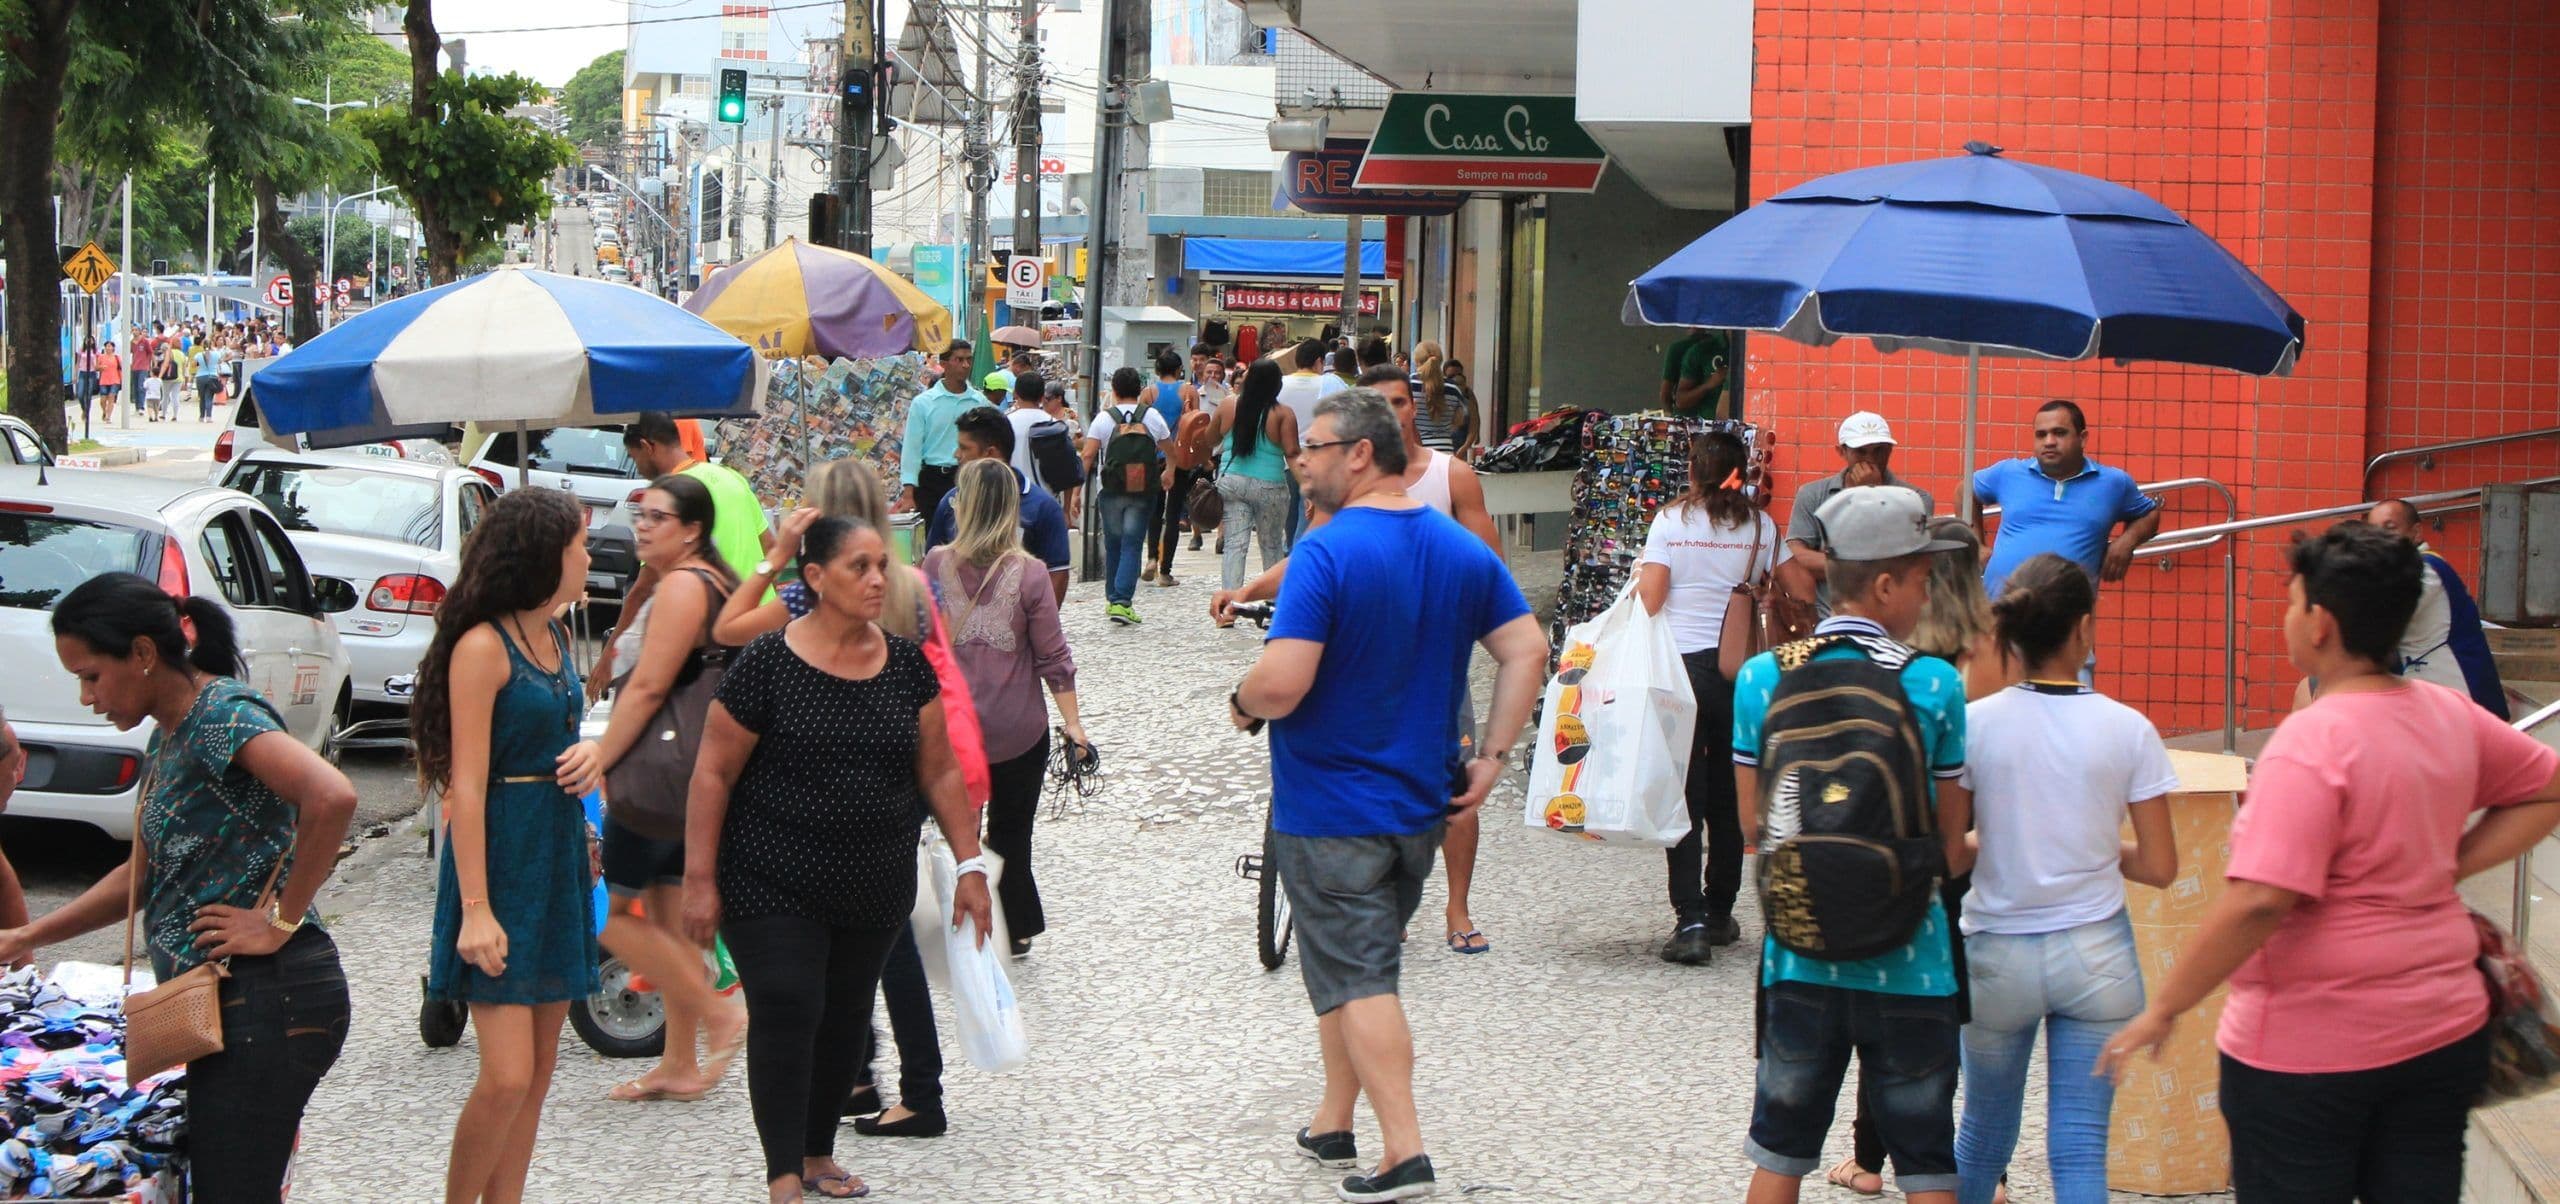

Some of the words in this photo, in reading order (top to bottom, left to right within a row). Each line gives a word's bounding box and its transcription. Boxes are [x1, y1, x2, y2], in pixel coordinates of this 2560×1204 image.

[1424, 103, 1503, 151] Casa
[1503, 104, 1550, 152] Pio
[1457, 168, 1498, 182] Sempre
[1501, 171, 1515, 181] na
[1517, 169, 1548, 181] moda
[1020, 266, 1031, 282] E
[1015, 290, 1034, 298] TAXI
[1227, 293, 1286, 307] BLUSAS
[1290, 297, 1299, 306] &
[1301, 296, 1376, 311] CAMIAS
[364, 445, 393, 457] TAXI
[58, 458, 99, 469] TAXI
